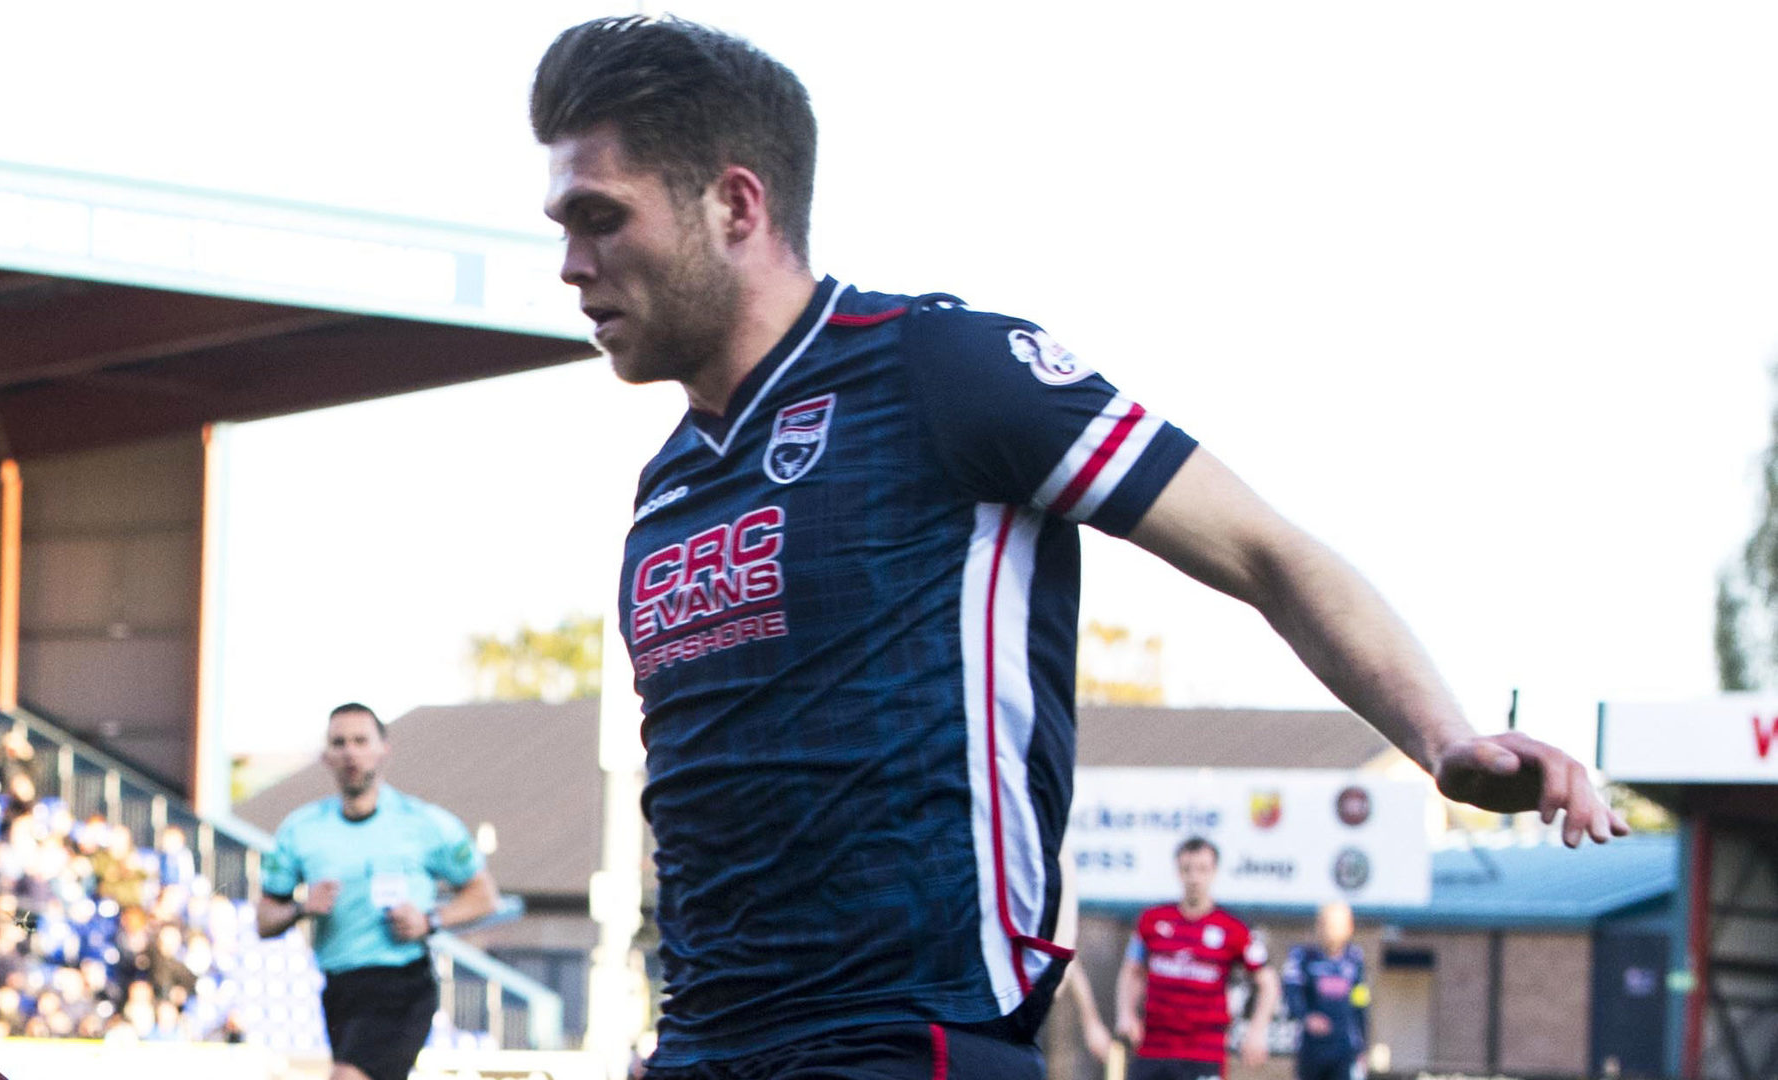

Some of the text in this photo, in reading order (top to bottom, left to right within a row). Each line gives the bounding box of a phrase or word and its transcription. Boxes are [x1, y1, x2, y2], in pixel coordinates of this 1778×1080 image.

[632, 505, 785, 606] CRC
[630, 559, 785, 645] EVANS
[634, 611, 790, 681] OFFSHORE
